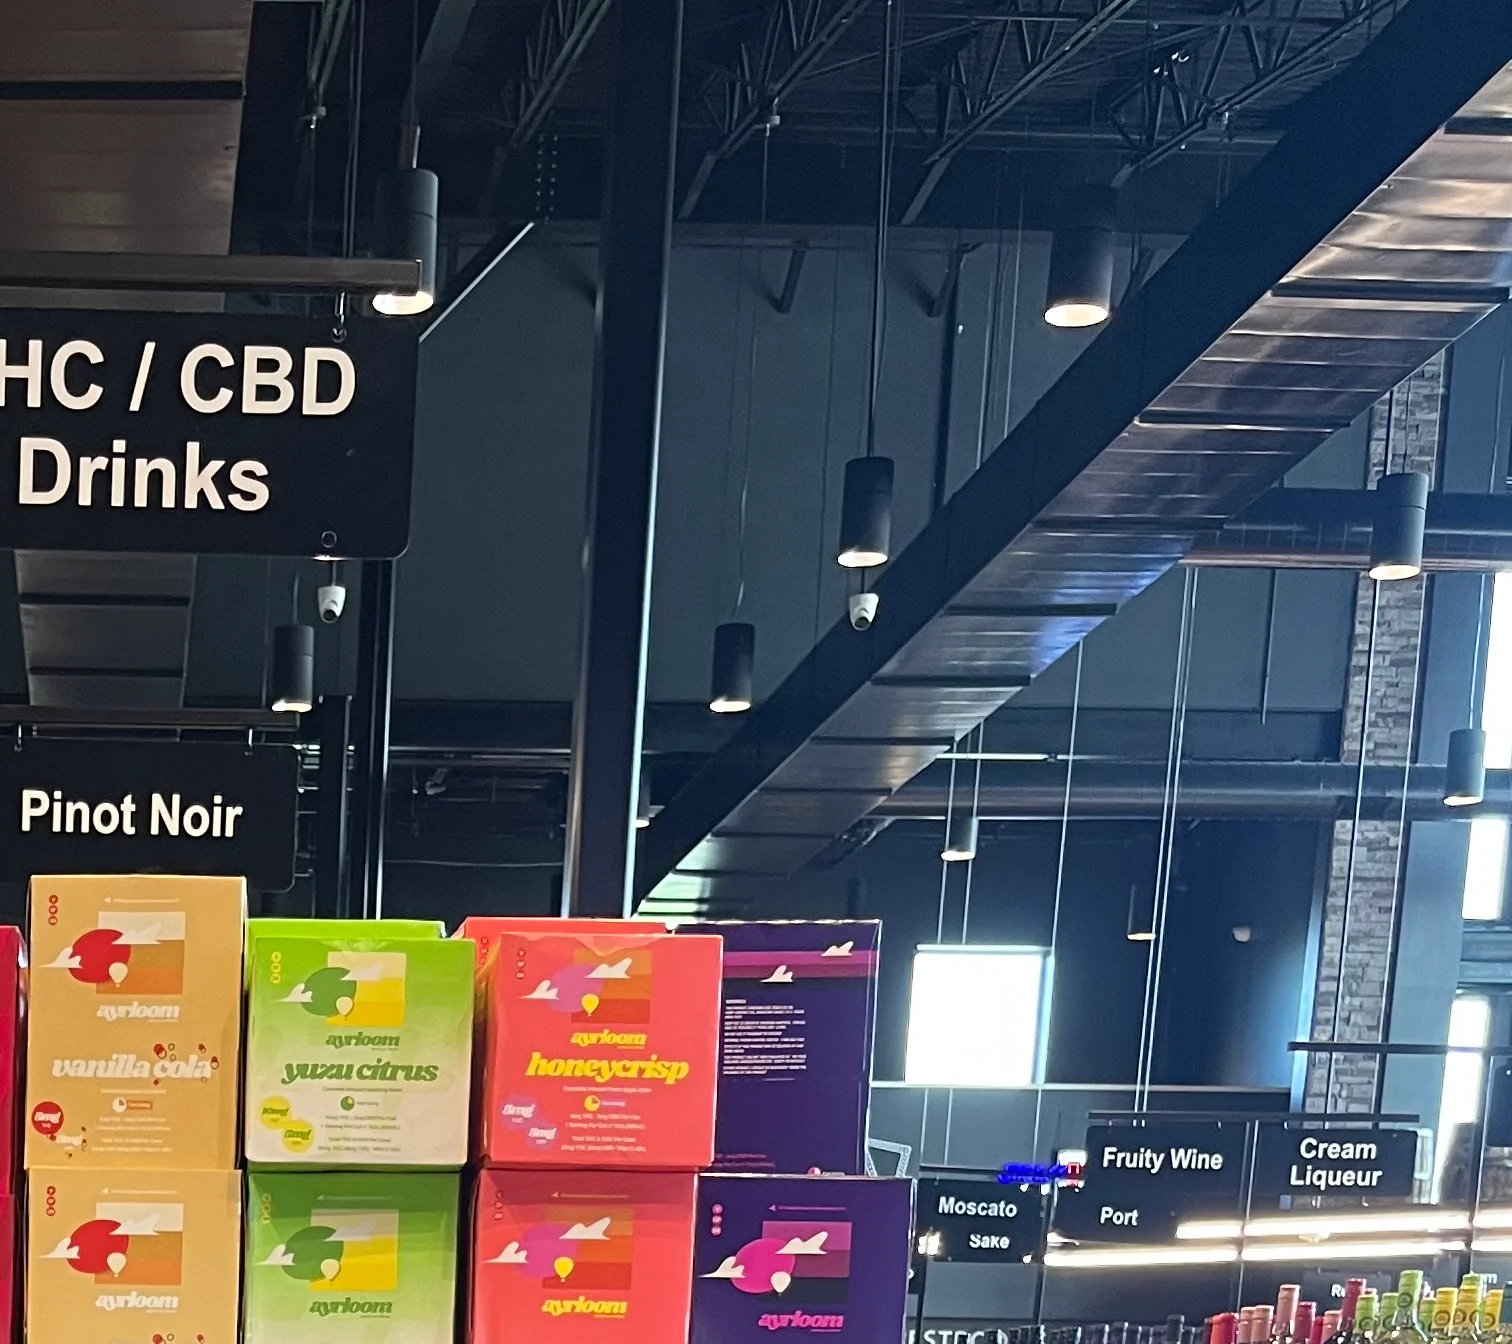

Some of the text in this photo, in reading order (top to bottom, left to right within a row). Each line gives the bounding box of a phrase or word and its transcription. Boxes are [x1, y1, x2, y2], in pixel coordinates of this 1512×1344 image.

[129, 342, 156, 412] /
[179, 345, 356, 417] CBD
[17, 437, 270, 512] Drinks
[21, 790, 243, 839] Pinot Noir
[1102, 1147, 1223, 1174] Fruity Wine
[1299, 1138, 1377, 1161] Cream
[1290, 1165, 1383, 1193] Liqueur
[938, 1197, 1017, 1218] Moscato
[1100, 1208, 1138, 1226] Port
[969, 1234, 1010, 1250] Sake
